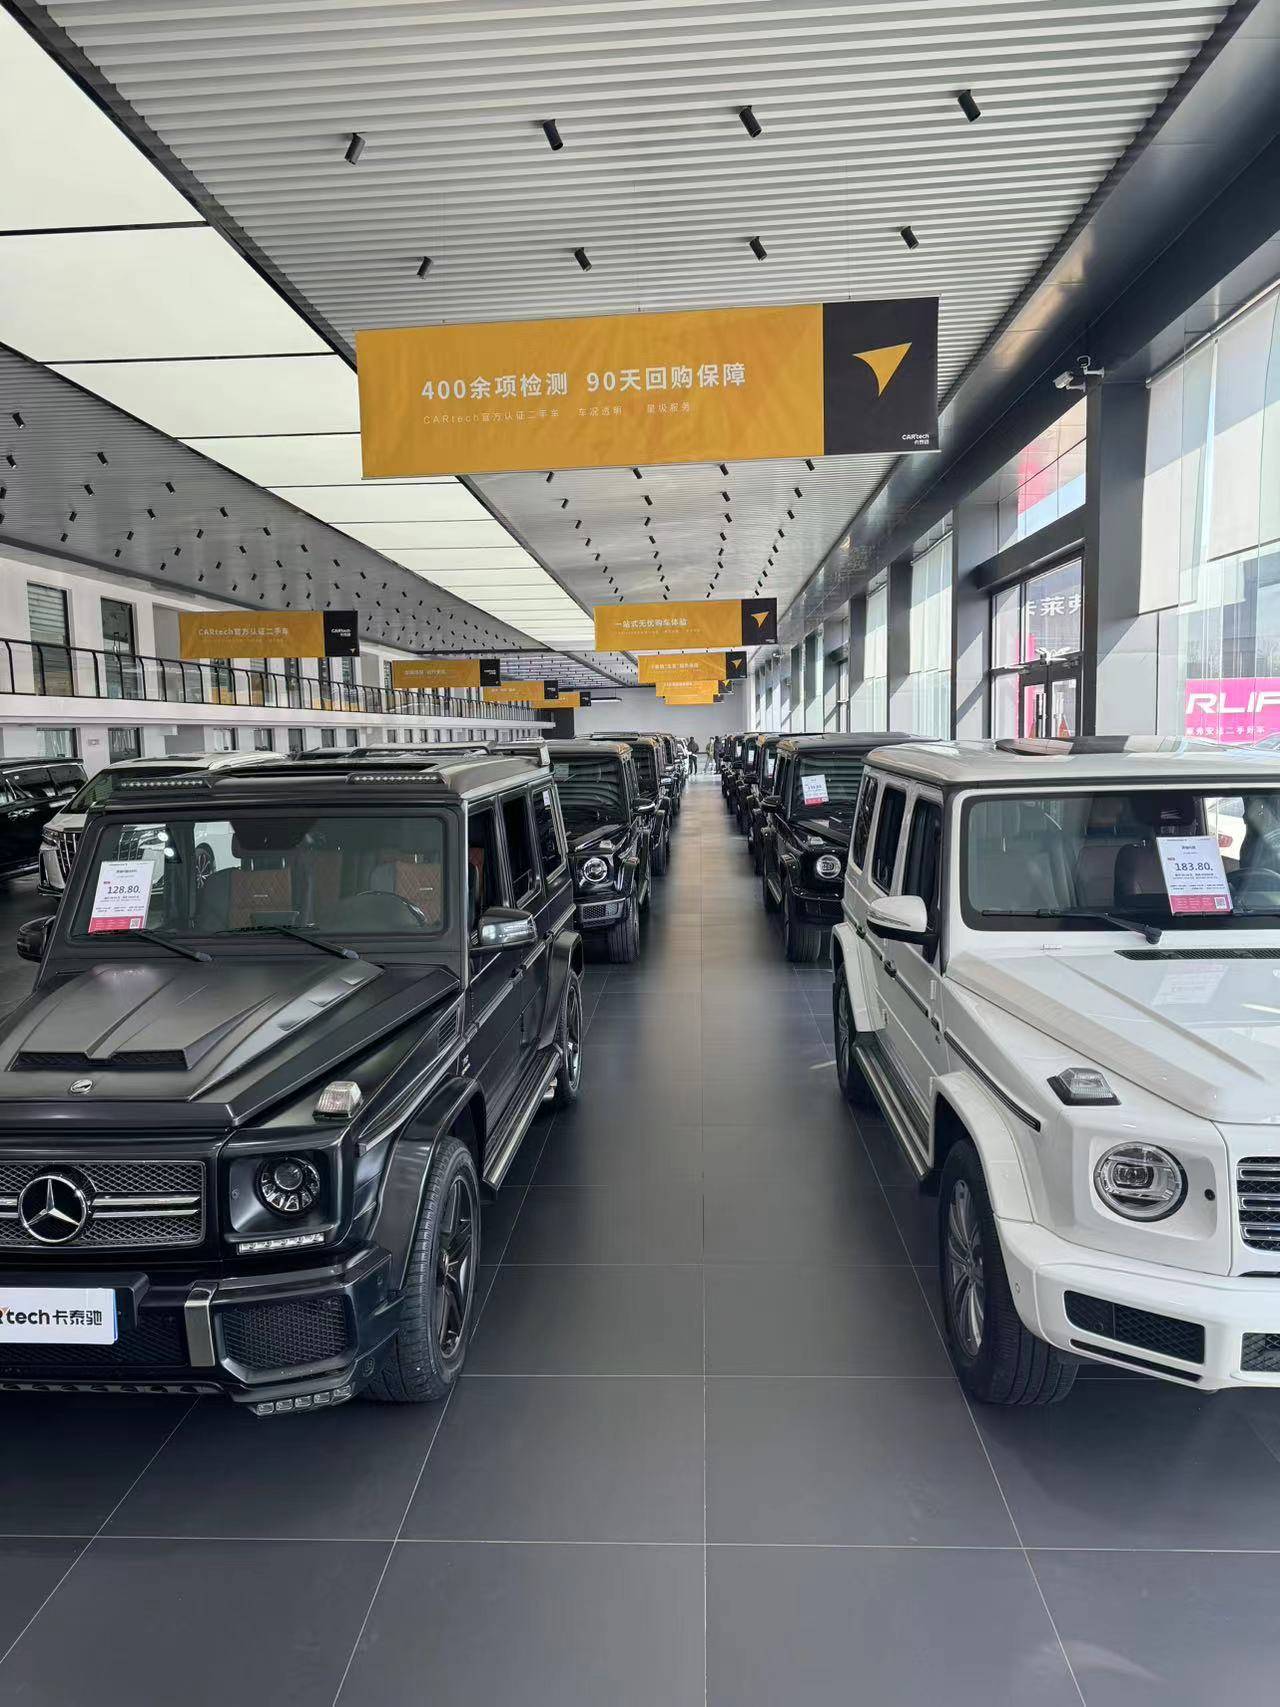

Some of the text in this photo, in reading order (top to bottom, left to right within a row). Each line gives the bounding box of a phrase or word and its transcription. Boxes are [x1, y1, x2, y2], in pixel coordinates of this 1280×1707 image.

[421, 362, 746, 400] 400余项检测 90天回购保障
[0, 1309, 102, 1326] tech卡泰驰
